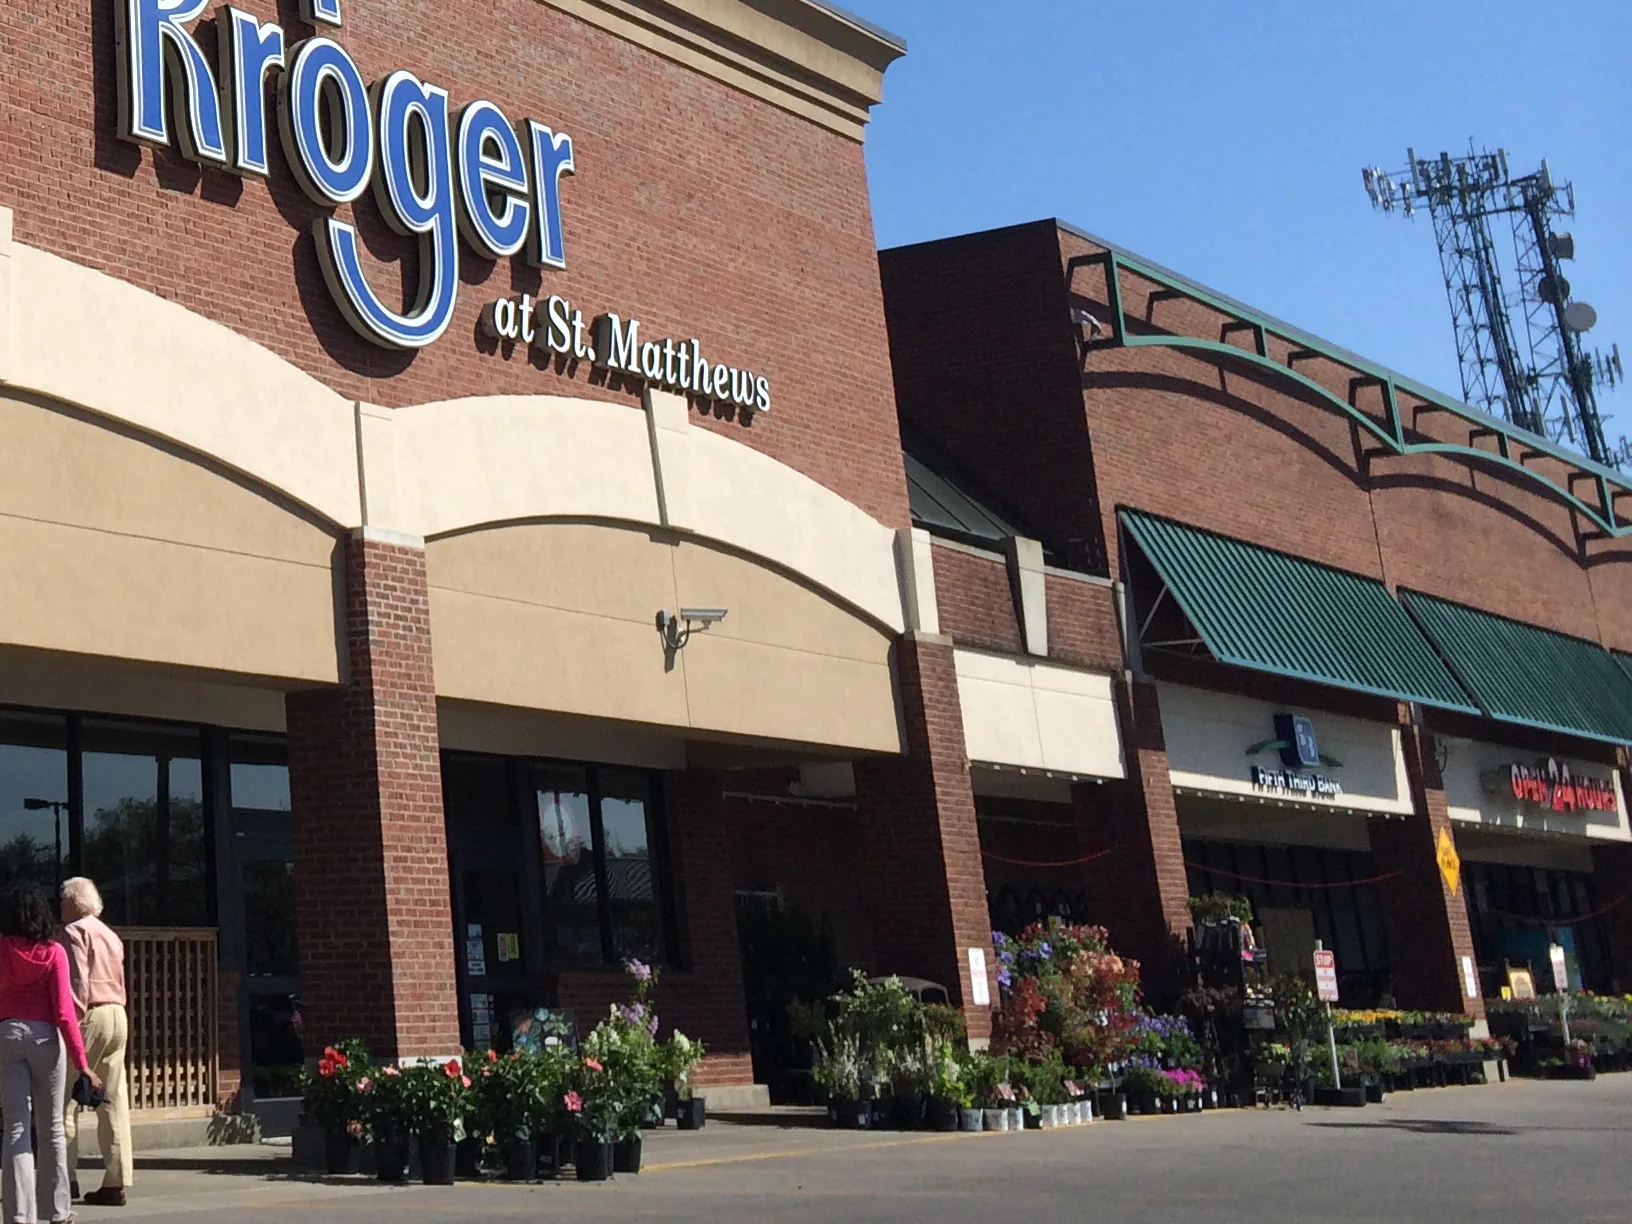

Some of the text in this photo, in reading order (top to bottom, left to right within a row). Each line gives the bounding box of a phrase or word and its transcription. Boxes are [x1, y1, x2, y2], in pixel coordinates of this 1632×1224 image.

[494, 293, 770, 411] at St. Matthews
[1257, 765, 1343, 794] FIFTH THIRD BANK
